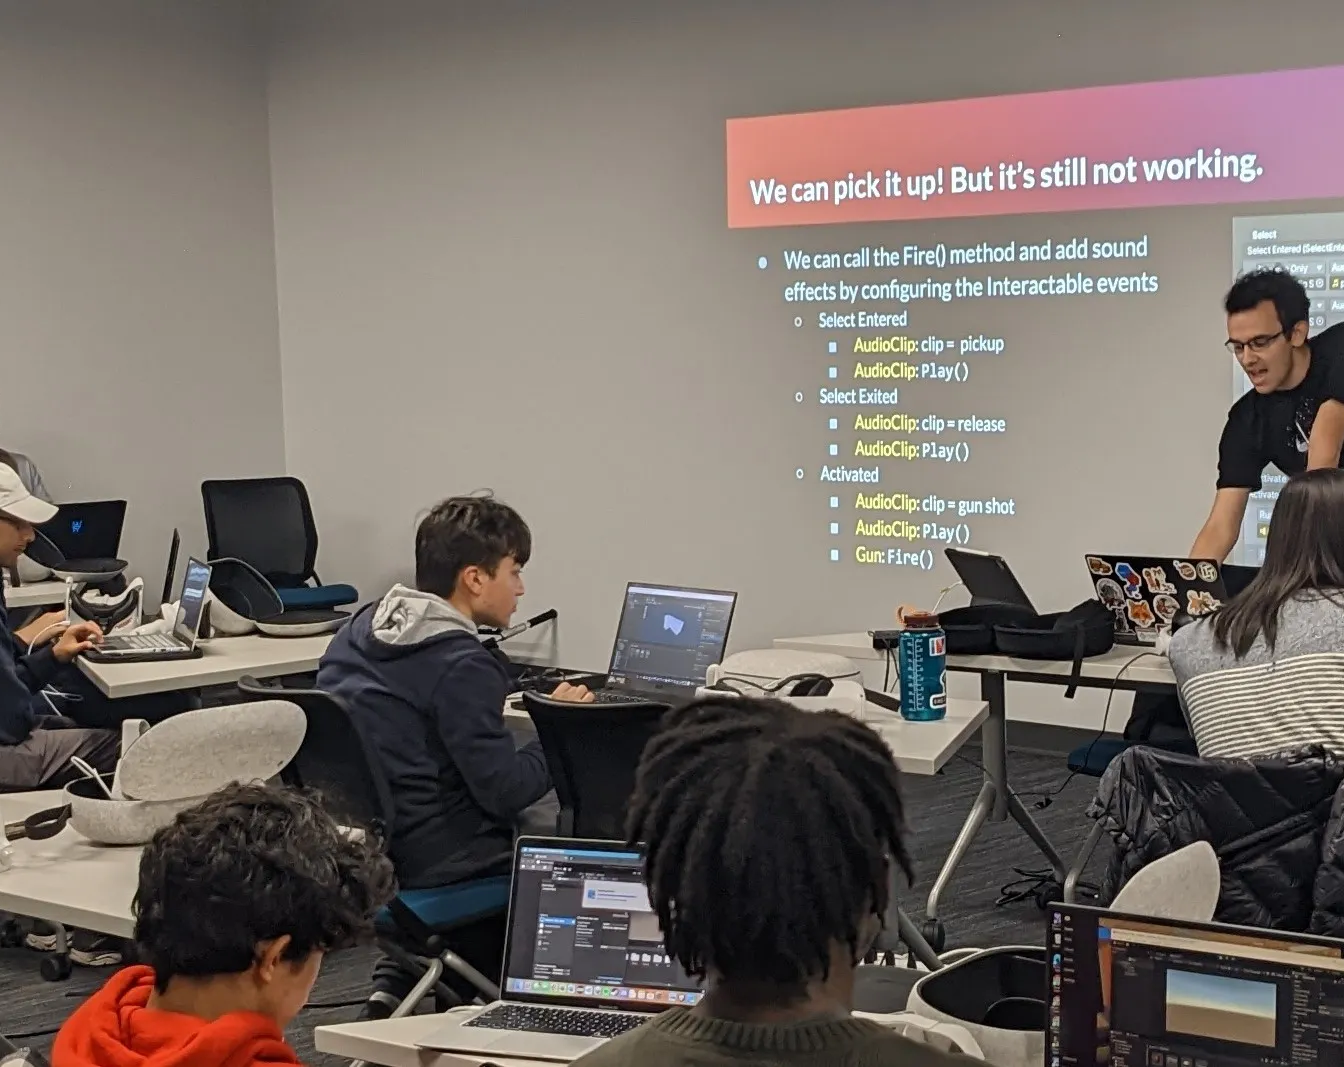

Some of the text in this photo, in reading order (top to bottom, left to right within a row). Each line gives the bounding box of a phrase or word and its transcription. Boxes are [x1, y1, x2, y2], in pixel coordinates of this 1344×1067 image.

[749, 147, 1264, 206] We can pick it up! But it’s still not working.
[1252, 229, 1277, 240] Select
[784, 234, 1148, 270] We can call the Fire() method and add sound
[1247, 245, 1271, 256] Select
[1272, 243, 1301, 255] Entered
[784, 271, 1159, 304] effects by configuring the Interactable events
[818, 310, 908, 329] Select Entered
[853, 335, 1005, 355] AudioClip: clip = pickup
[853, 362, 969, 382] AudioClip: Play()
[819, 387, 898, 405] Select Exited
[854, 413, 1006, 434] AudioClip: clip = release
[854, 440, 970, 462] AudioClip: Play()
[820, 465, 879, 483] Activated
[855, 492, 1015, 517] AudioClip: clip = gun shot
[855, 519, 970, 544] AudioClip: Play()
[855, 546, 934, 569] Gun: Fire()
